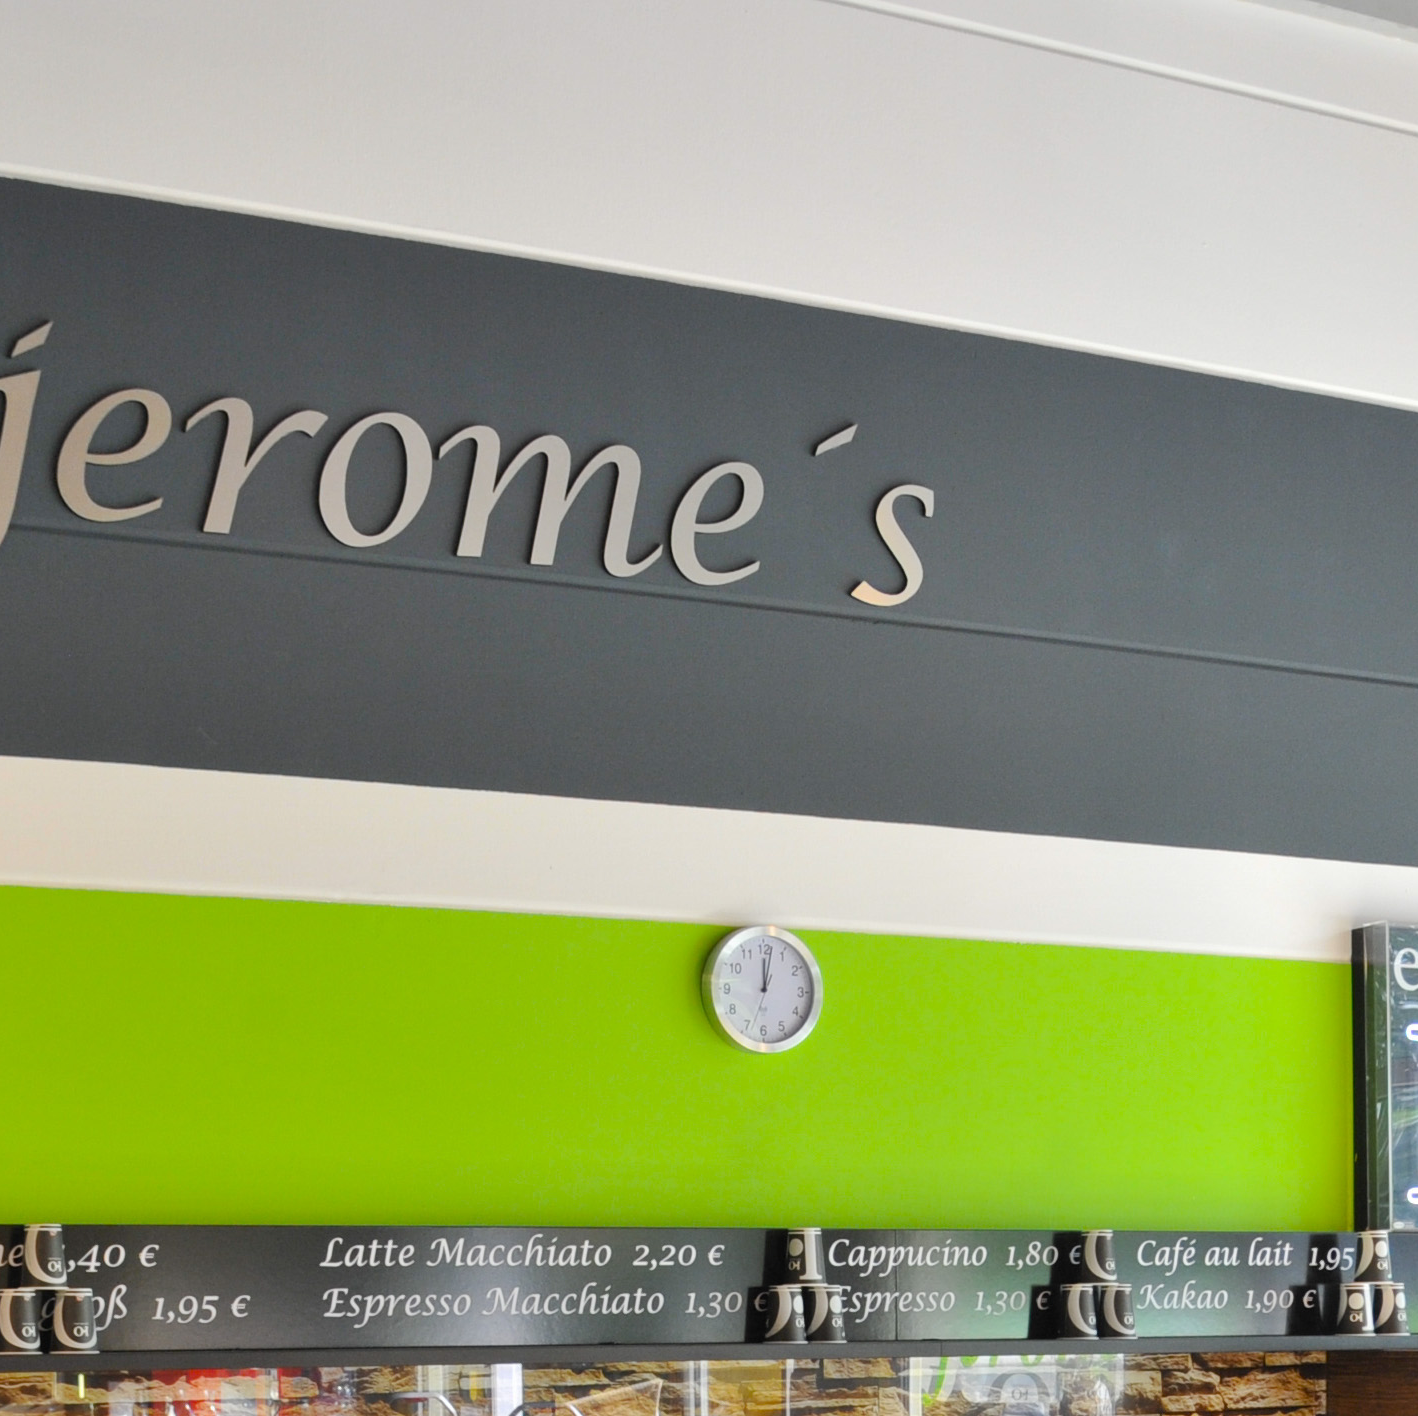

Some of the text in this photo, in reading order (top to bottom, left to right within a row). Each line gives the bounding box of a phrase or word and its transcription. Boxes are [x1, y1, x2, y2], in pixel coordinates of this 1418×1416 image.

[741, 949, 752, 960] 11
[758, 943, 771, 956] 12
[779, 950, 785, 962] 1
[729, 962, 742, 975] 10
[791, 965, 799, 977] 2
[723, 982, 731, 995] 9
[797, 986, 805, 998] 3
[728, 1003, 737, 1015] 8
[792, 1005, 799, 1017] 4
[743, 1019, 751, 1031] 7
[759, 1024, 768, 1037] 6
[777, 1020, 786, 1033] 5
[319, 1233, 725, 1269] Latte Macchiato 2,20 €
[1136, 1236, 1356, 1278] Café au lait 1,95
[61, 1244, 126, 1273] ,40
[139, 1243, 159, 1269] €
[828, 1238, 1082, 1280] Cappucino 1,80 €
[322, 1282, 770, 1328] Espresso Macchiato 1,30 €
[973, 1290, 1027, 1316] 1,30
[1036, 1290, 1051, 1311] €
[1136, 1283, 1317, 1314] Kakao 1,90 €
[151, 1295, 218, 1324] 1,95
[231, 1295, 251, 1319] €
